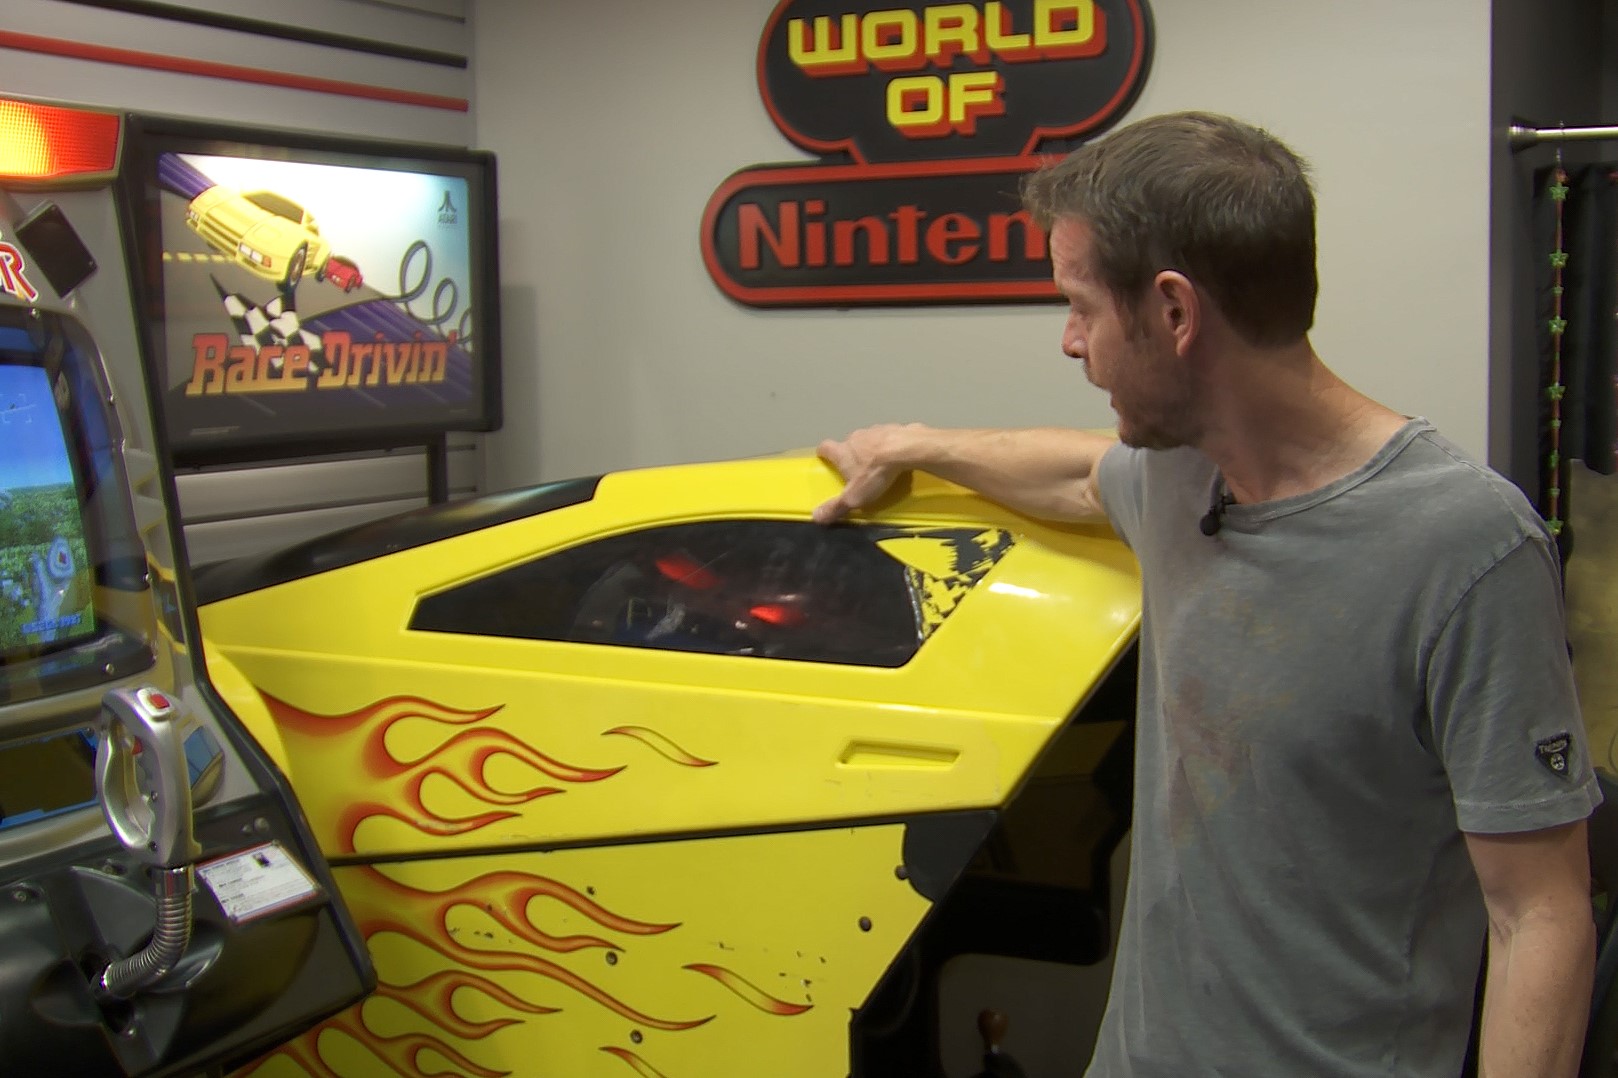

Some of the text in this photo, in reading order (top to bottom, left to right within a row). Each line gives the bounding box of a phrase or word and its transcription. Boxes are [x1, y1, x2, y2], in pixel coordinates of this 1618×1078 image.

[788, 0, 1097, 69] WORLD
[886, 71, 1000, 128] OF
[185, 332, 311, 396] Race
